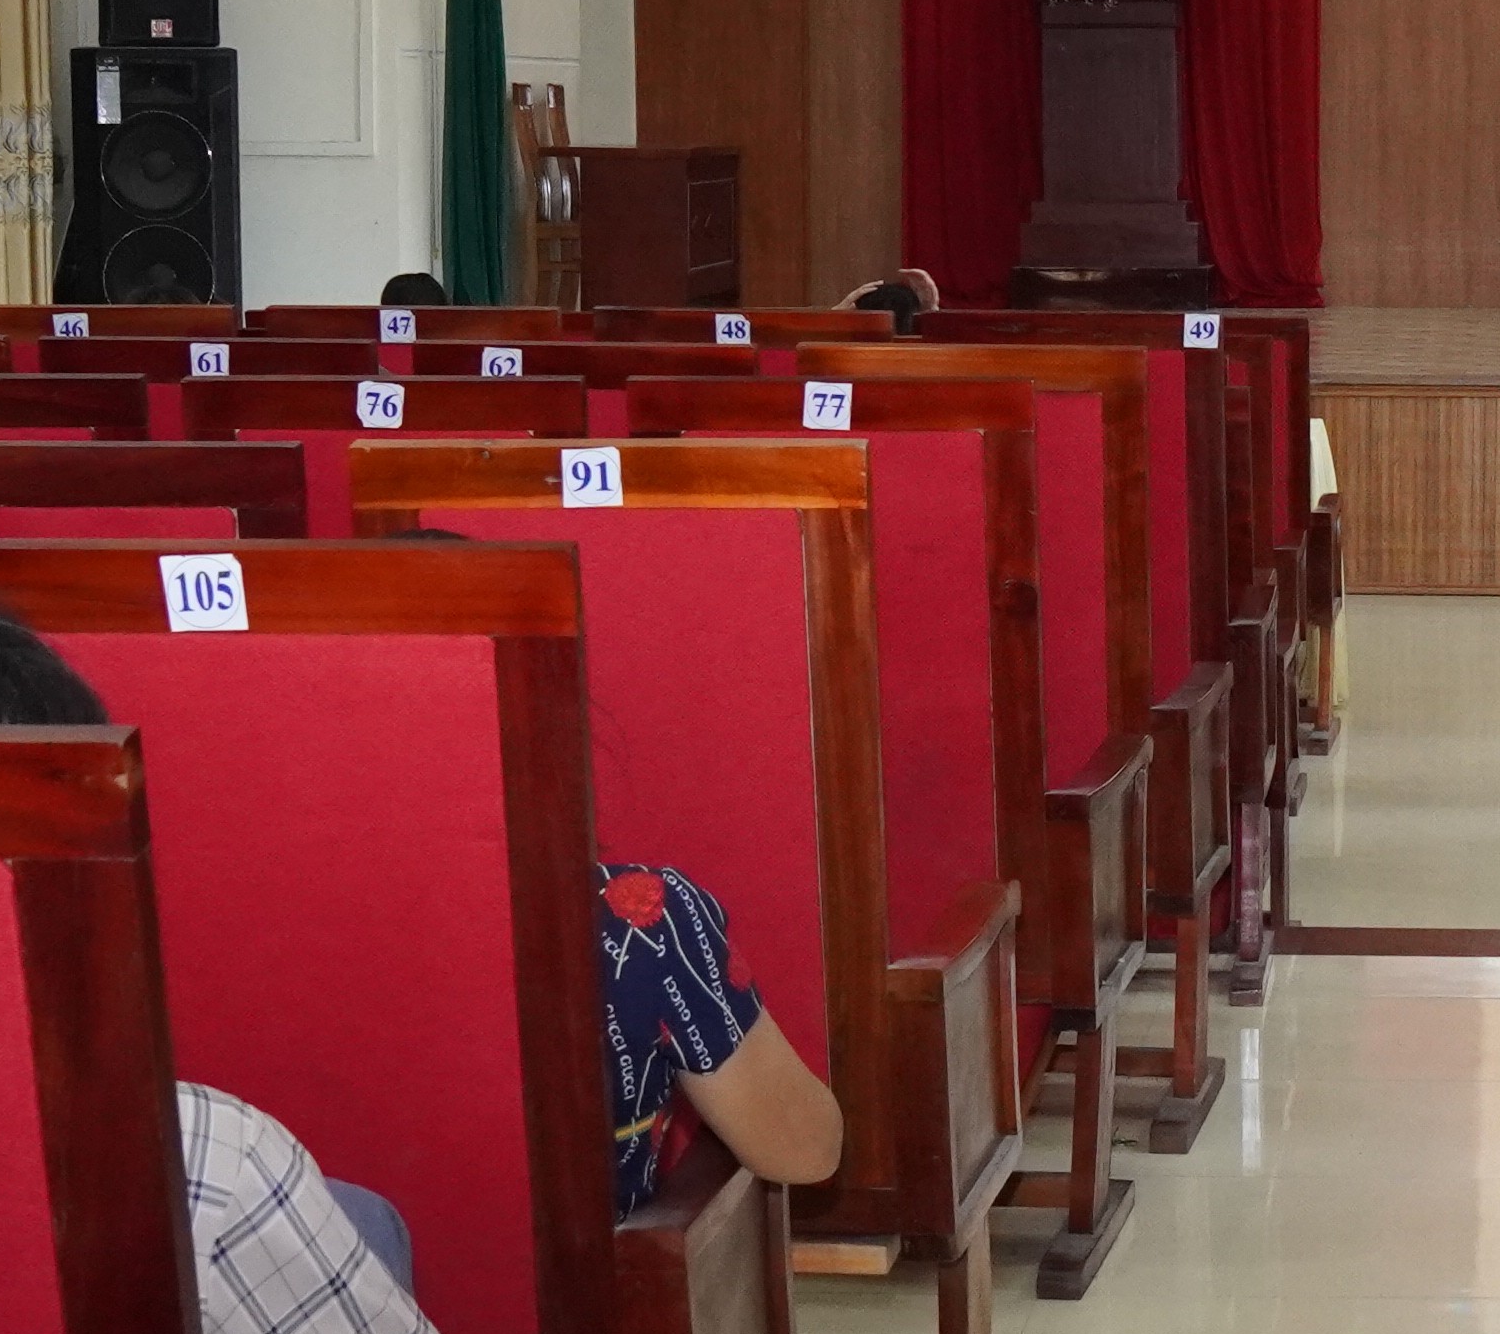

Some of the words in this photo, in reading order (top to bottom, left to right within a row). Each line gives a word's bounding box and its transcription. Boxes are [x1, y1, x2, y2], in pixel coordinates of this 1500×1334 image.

[59, 320, 84, 336] 46
[386, 316, 412, 335] 47
[721, 320, 747, 339] 48
[1189, 320, 1215, 340] 49
[197, 351, 223, 374] 61
[488, 355, 516, 375] 62
[365, 391, 398, 418] 76
[812, 392, 846, 419] 77
[571, 461, 611, 492] 91
[175, 571, 236, 612] 105
[663, 975, 692, 1022] GUCCI
[687, 1024, 713, 1071] GUCCI
